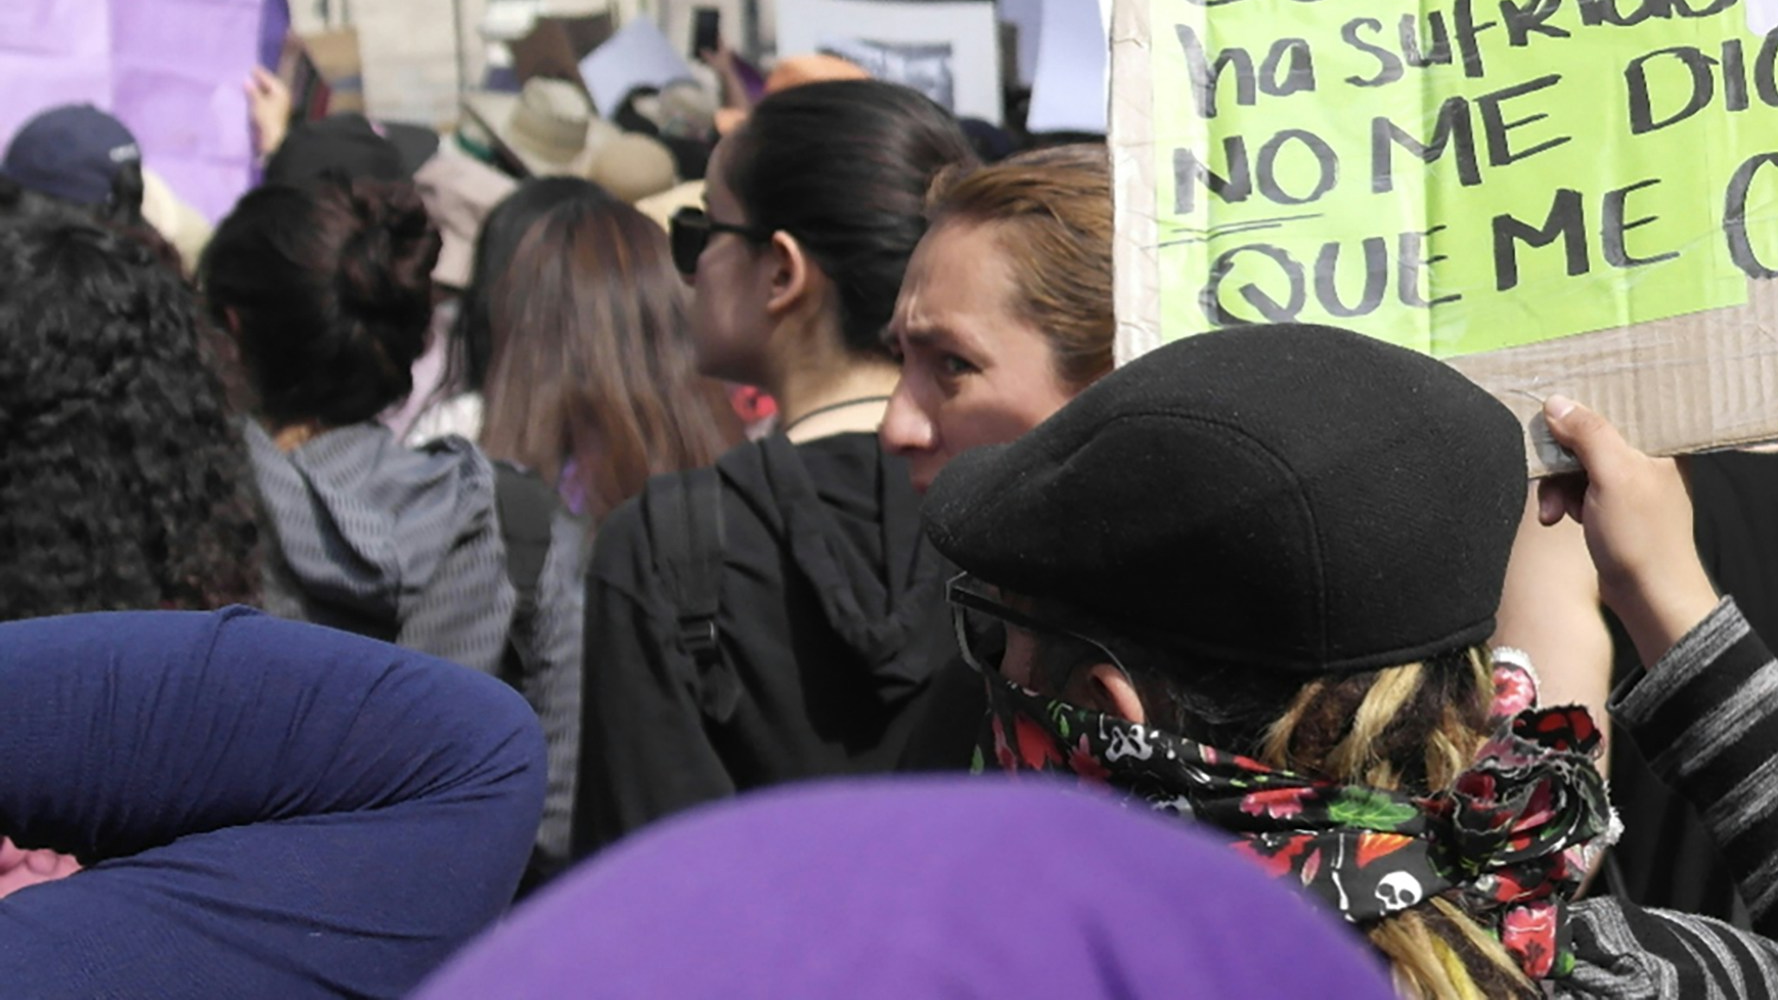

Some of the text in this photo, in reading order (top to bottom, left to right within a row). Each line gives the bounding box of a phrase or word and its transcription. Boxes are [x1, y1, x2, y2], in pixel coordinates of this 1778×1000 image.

[1174, 23, 1316, 119] ha
[1173, 129, 1339, 215] NO
[1371, 74, 1572, 194] ME
[1198, 225, 1462, 327] QUE
[1492, 178, 1680, 292] ME
